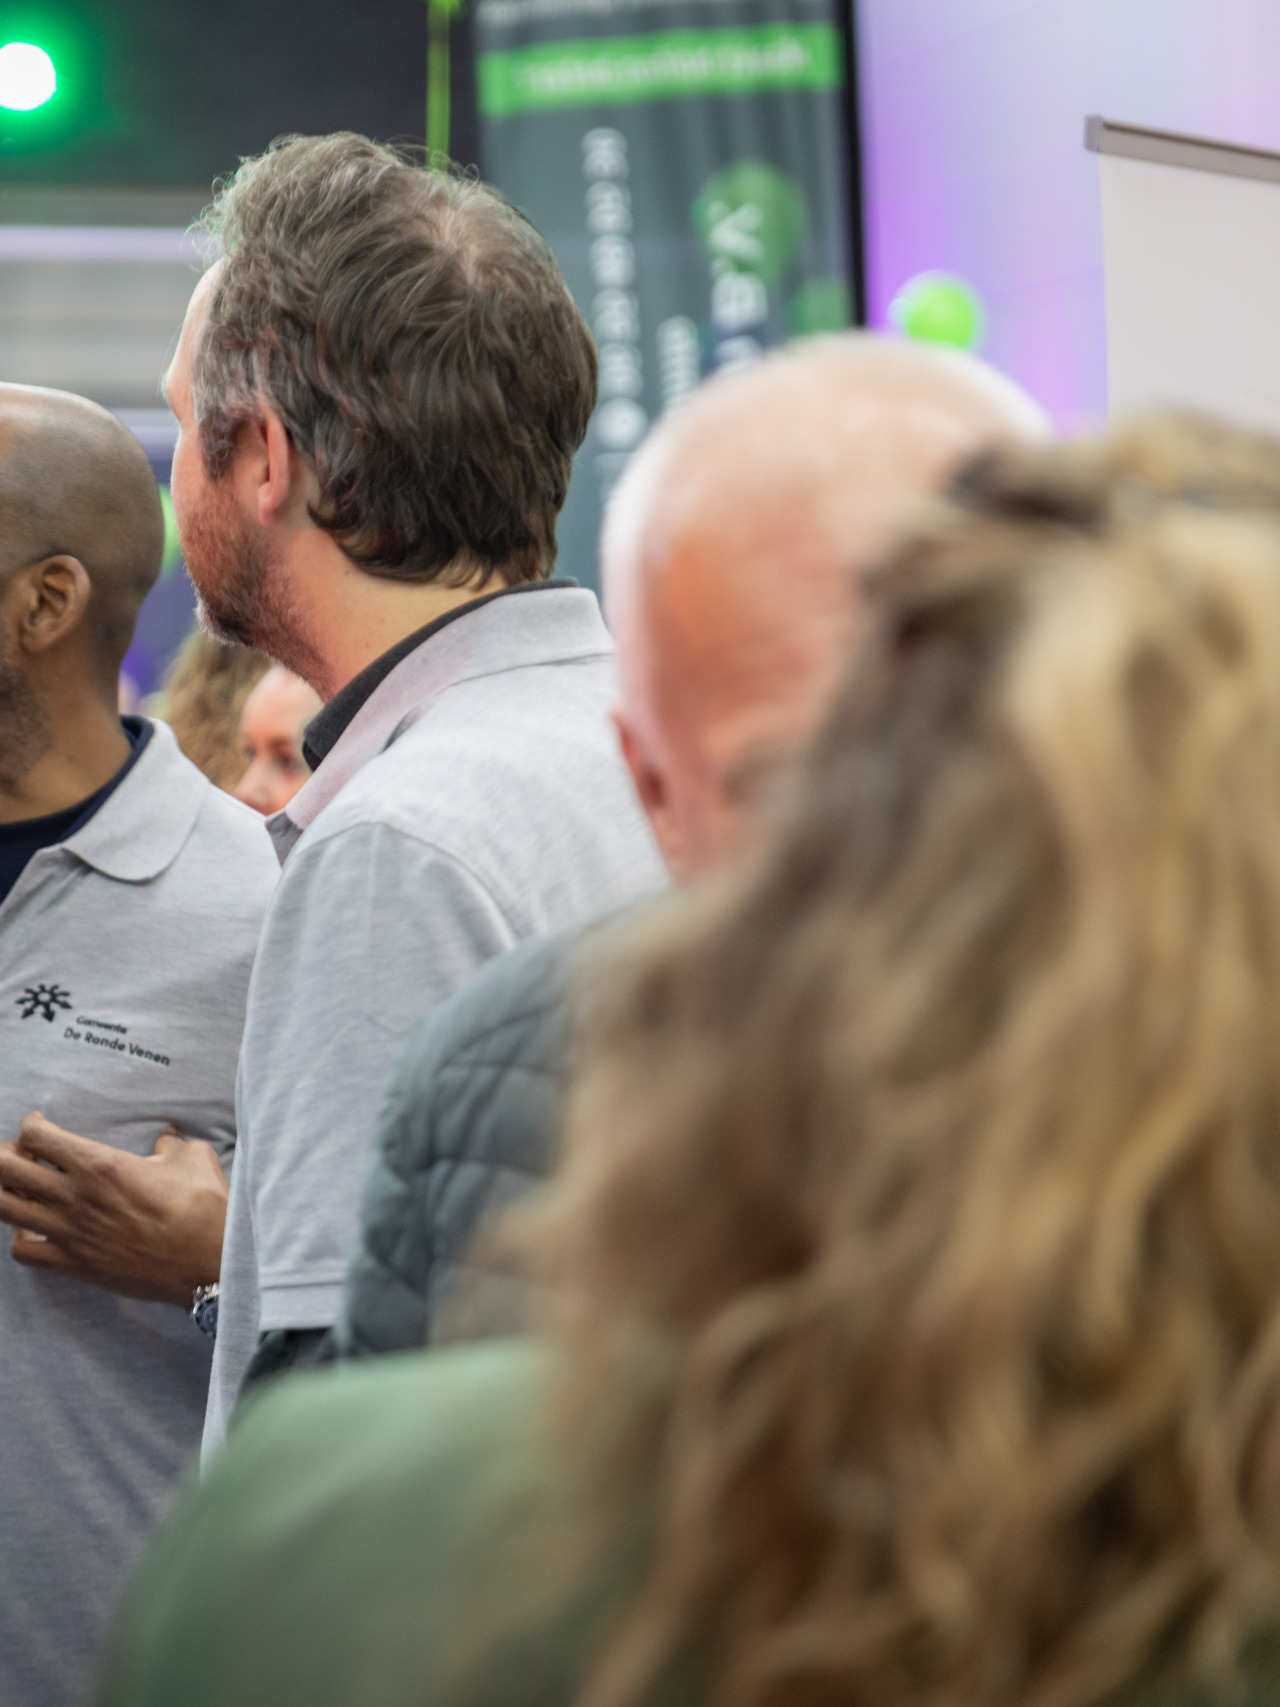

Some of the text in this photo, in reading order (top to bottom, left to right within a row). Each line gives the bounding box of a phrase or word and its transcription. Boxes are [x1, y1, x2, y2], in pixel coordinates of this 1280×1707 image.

[64, 1027, 170, 1066] De Ronde Venen
